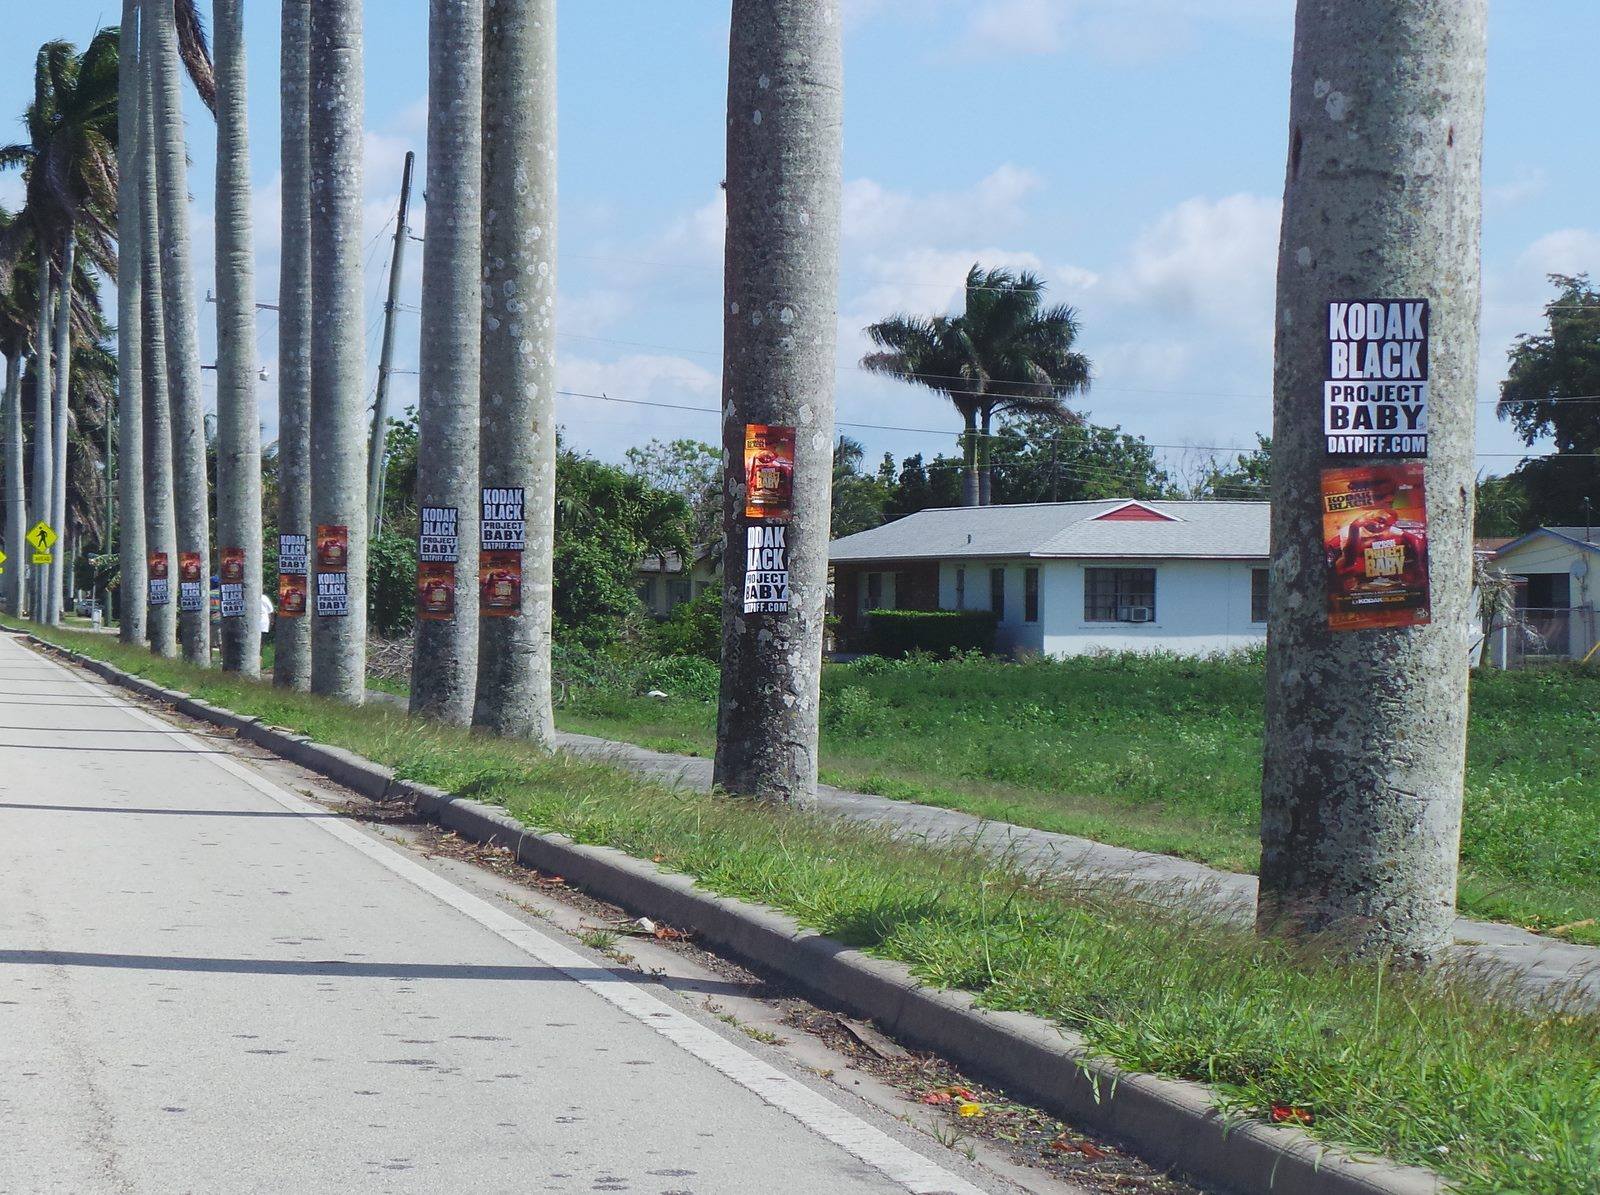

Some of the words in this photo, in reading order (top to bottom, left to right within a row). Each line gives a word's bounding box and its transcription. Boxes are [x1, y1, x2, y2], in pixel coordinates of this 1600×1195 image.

[1329, 302, 1424, 340] KODAK
[1331, 341, 1422, 379] BLACK
[1330, 385, 1424, 402] PROJECT
[1330, 404, 1424, 430] BABY
[1328, 436, 1426, 453] DATPIFF.COM
[484, 489, 522, 504] KODAK
[422, 508, 456, 522] KODAK
[484, 504, 522, 520] BLACK
[423, 522, 456, 536] BLACK
[484, 522, 522, 530] PROJECT
[280, 535, 306, 545] KODAK
[484, 530, 522, 540] BABY
[748, 526, 786, 549] ODAK
[281, 545, 306, 555] BLACK
[422, 544, 456, 554] BABY
[747, 548, 784, 571] LACK
[318, 574, 346, 584] KODAK
[319, 584, 346, 595] BLACK
[746, 584, 786, 600] BABY
[320, 601, 347, 609] BABY
